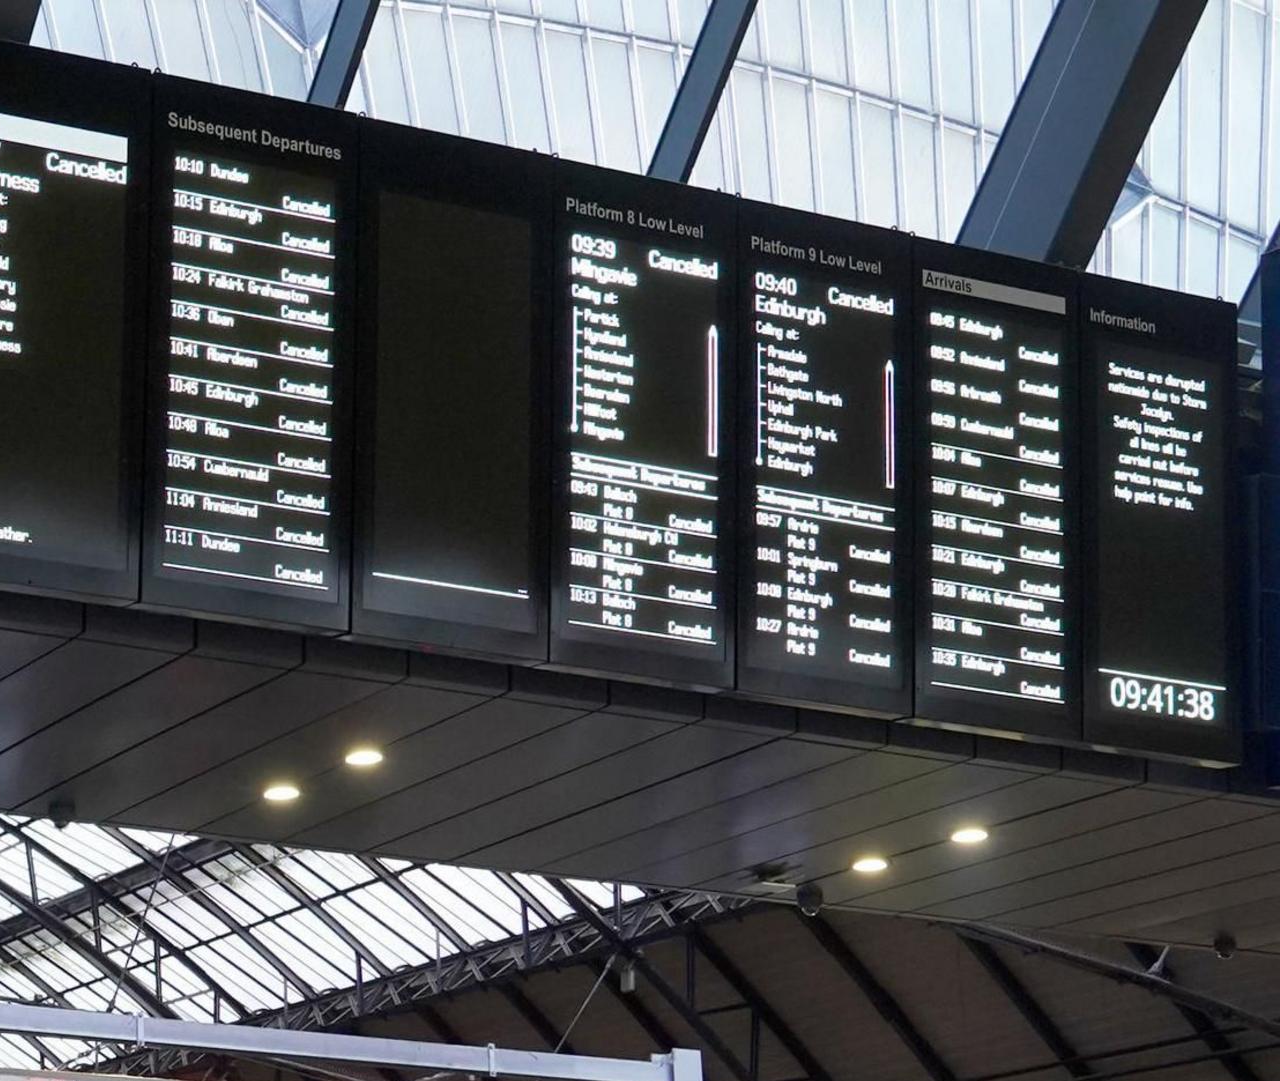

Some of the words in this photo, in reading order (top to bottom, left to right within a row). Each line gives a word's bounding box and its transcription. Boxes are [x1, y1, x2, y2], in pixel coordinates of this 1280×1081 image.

[168, 112, 258, 144] Subsequent
[261, 130, 342, 161] Departures
[46, 152, 127, 185] Cancelled
[175, 155, 204, 175] 10:10
[210, 163, 250, 184] Dundee
[174, 192, 203, 212] 10:15
[209, 200, 263, 225] Edinburgh
[566, 197, 623, 223] Platform
[627, 210, 635, 225] 8
[639, 212, 667, 232] Low
[669, 219, 704, 239] Level
[571, 233, 616, 260] 09:39
[751, 236, 805, 260] Platform
[809, 246, 817, 262] 9
[820, 250, 845, 268] Low
[849, 256, 882, 275] Level
[648, 249, 718, 281] Cancelled
[755, 271, 797, 296] 09:40
[925, 272, 972, 294] Arrivals
[755, 294, 827, 326] Edinburgh
[828, 286, 894, 316] Cancelled
[1090, 307, 1156, 334] Information
[164, 528, 193, 547] 11:11
[201, 534, 241, 553] Dundee
[275, 563, 324, 584] Cancelled
[1110, 676, 1215, 721] 09:41:38
